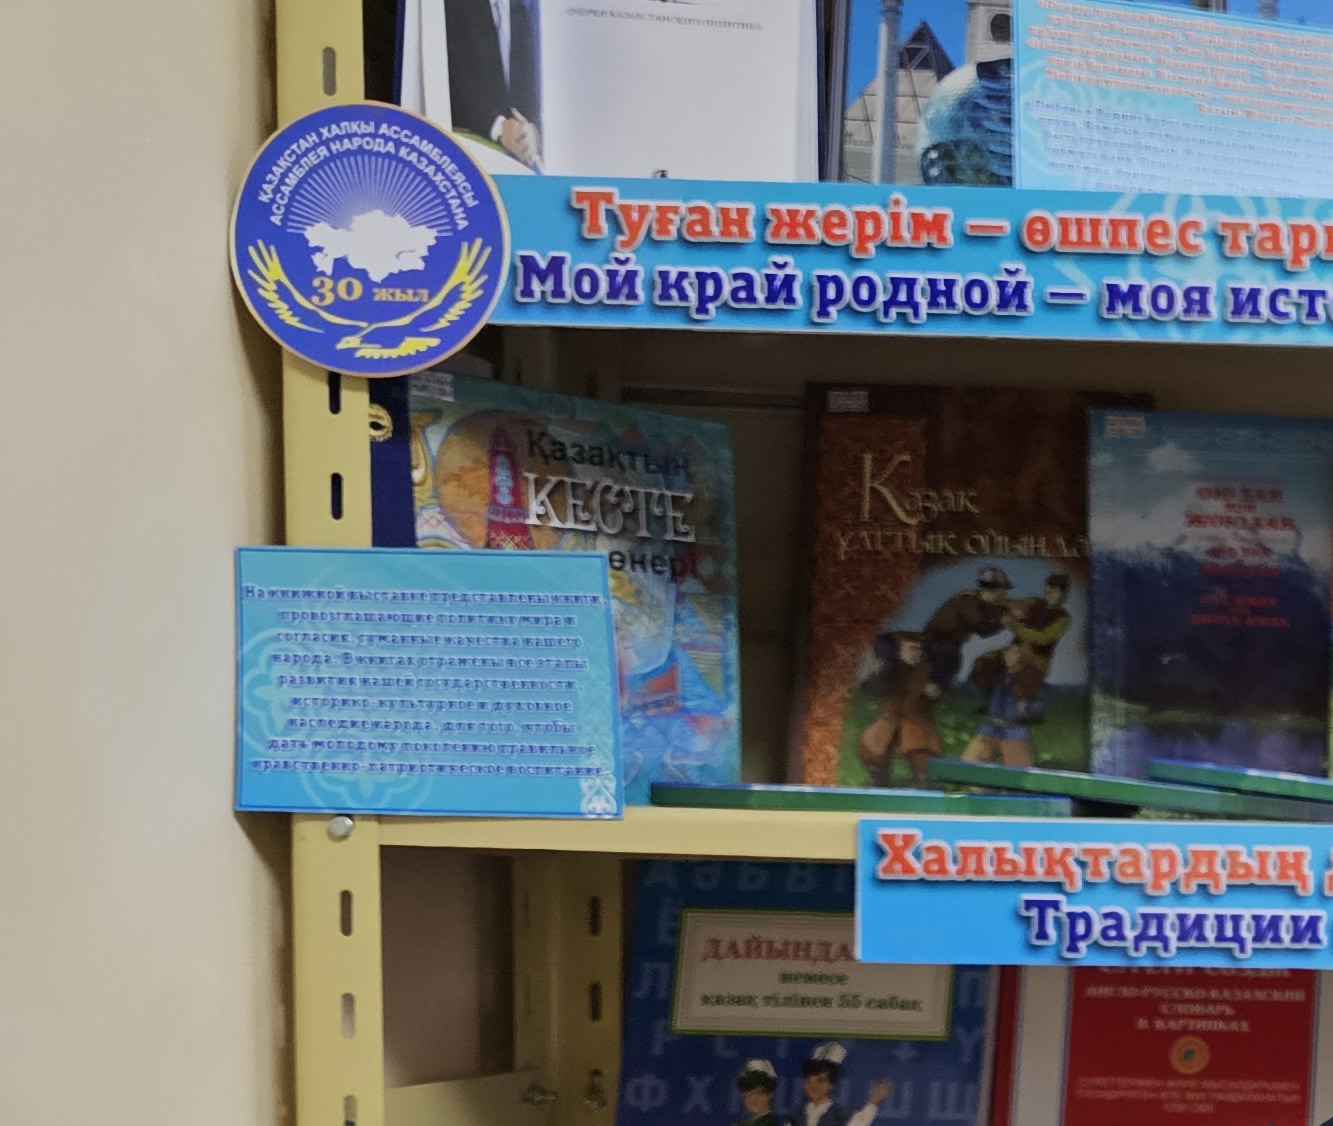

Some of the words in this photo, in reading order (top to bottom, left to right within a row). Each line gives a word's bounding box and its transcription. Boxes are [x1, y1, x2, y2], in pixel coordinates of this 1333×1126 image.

[270, 146, 331, 226] АССАМБЛЕЯ
[330, 137, 396, 154] НАРОДА
[398, 146, 469, 230] КАЗАХСТАНА
[379, 123, 479, 207] АССАМБЛЕЯСЫ
[574, 190, 755, 242] Туған
[766, 196, 951, 257] жерім
[1023, 210, 1202, 255] өшпес
[311, 276, 363, 306] 30
[517, 252, 643, 304] Мой
[656, 260, 799, 319] край
[814, 269, 1032, 320] родной
[1104, 280, 1211, 319] моя
[523, 470, 697, 544] КЕСТЕ
[876, 829, 1311, 893] Халықтардың
[1020, 895, 1324, 958] Традиции
[837, 993, 861, 1009] 55
